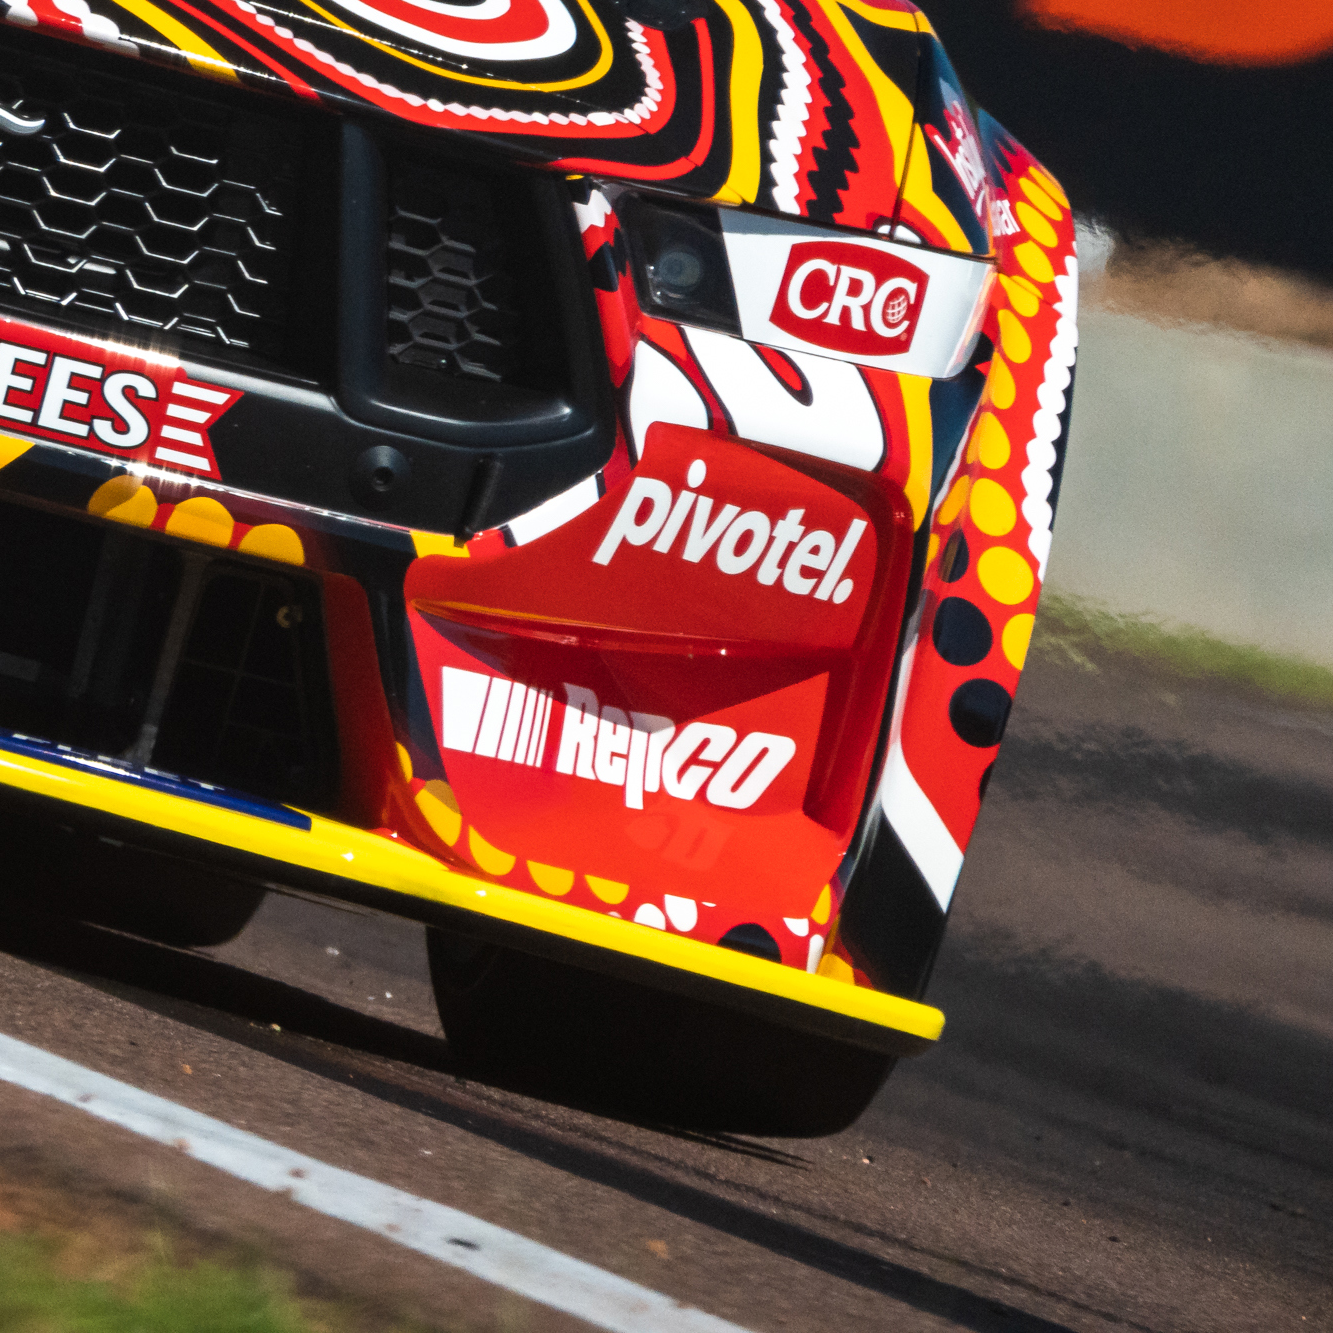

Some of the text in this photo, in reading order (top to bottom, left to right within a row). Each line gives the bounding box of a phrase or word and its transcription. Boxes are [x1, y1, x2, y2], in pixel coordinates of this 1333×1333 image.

[787, 257, 918, 339] CRC
[592, 459, 868, 605] pivotel.
[556, 681, 797, 811] Repco
